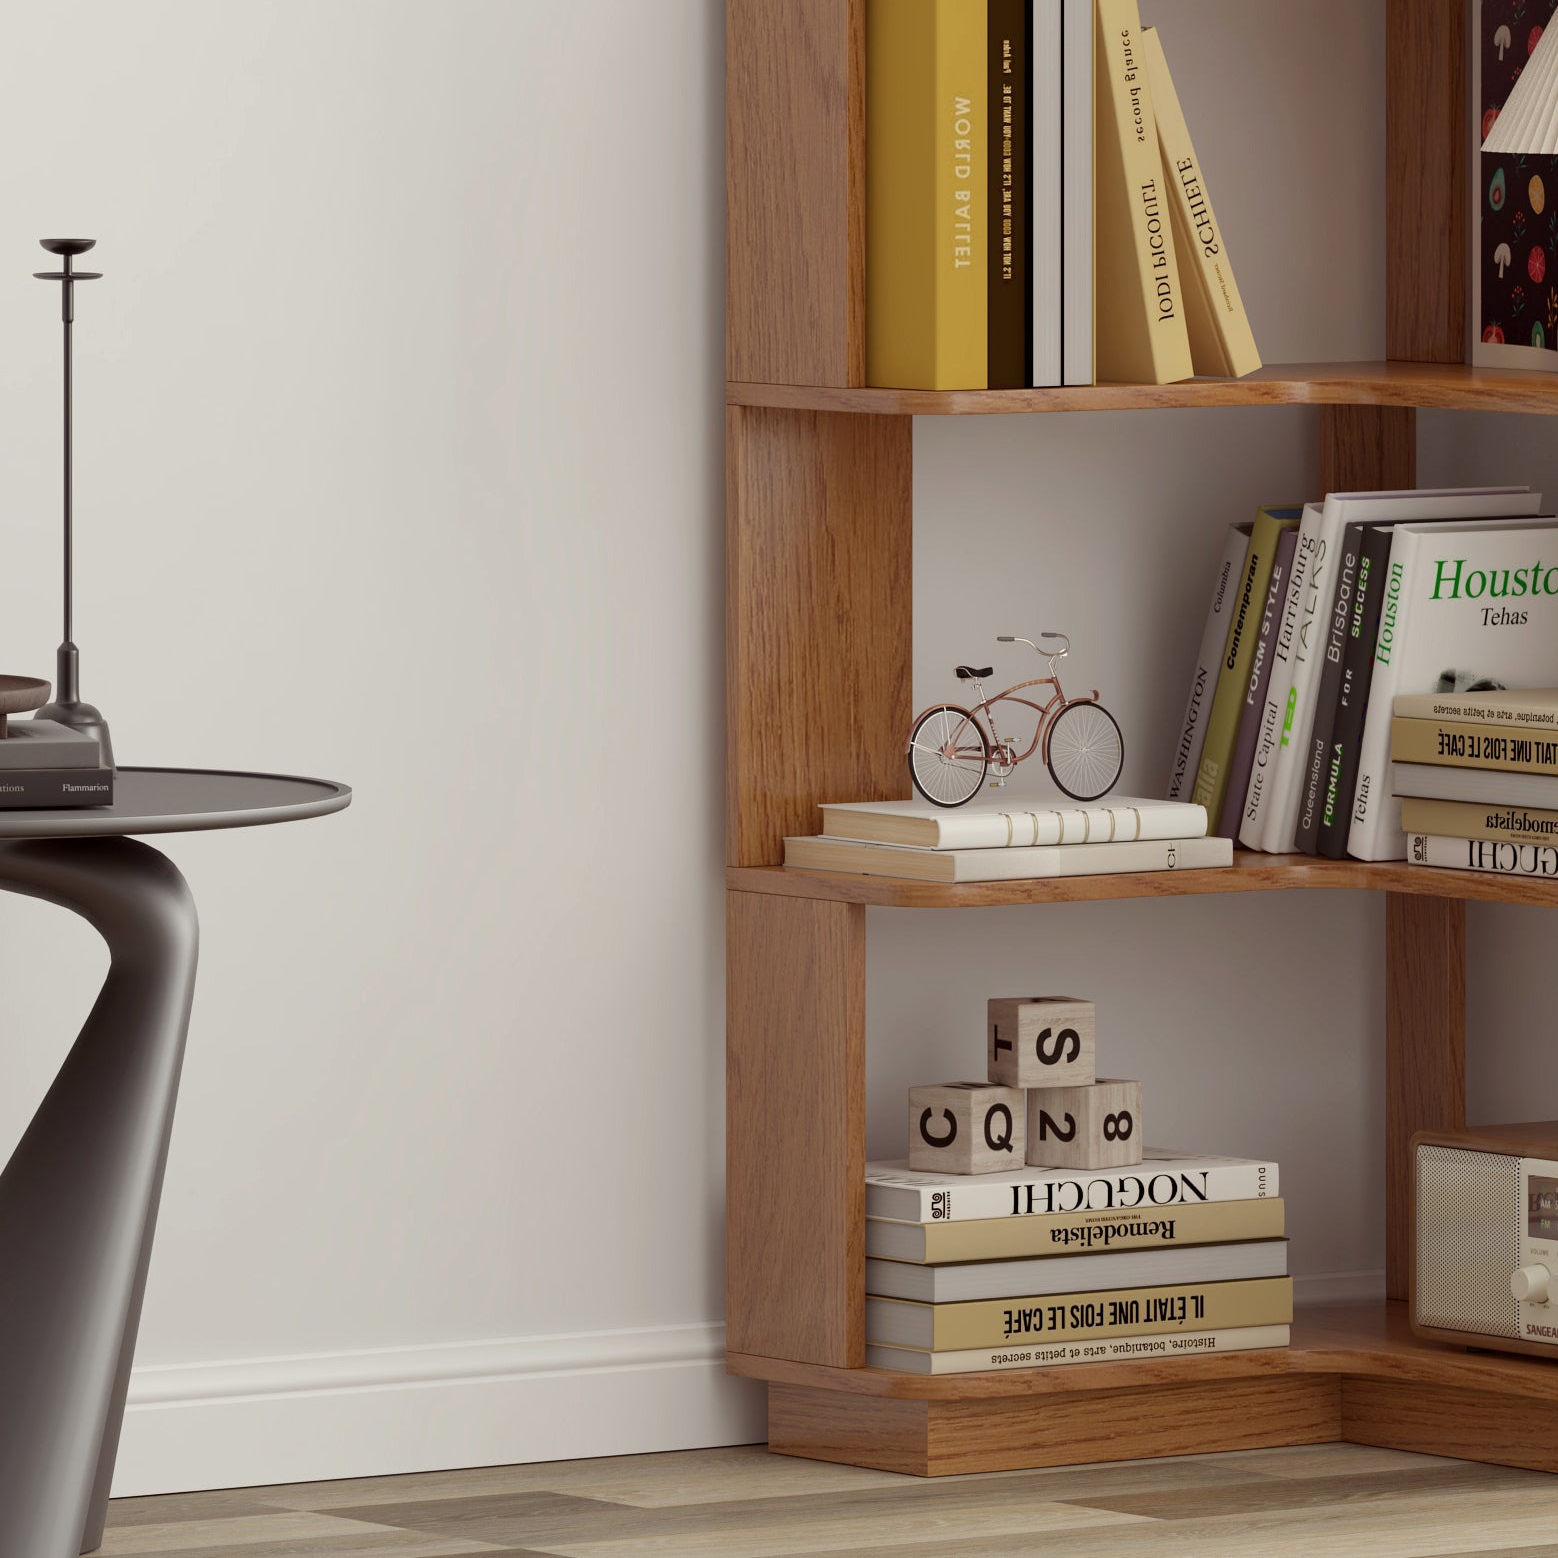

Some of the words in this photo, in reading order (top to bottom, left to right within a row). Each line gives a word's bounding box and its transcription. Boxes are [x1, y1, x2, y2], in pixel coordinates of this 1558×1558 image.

[1226, 554, 1259, 671] Contemporan
[1276, 533, 1316, 663] Harrisburg
[1327, 553, 1356, 663] Brisbane
[1376, 562, 1404, 667] Houston
[1480, 607, 1529, 626] Tehas
[1246, 639, 1267, 706] FORM
[1261, 566, 1283, 636] STYLE
[1169, 667, 1208, 798] WASHINGTON
[1214, 561, 1232, 614] Columbia
[1323, 743, 1344, 827] FORMULA
[1341, 669, 1353, 706] FOR
[1351, 556, 1371, 638] SUCCESS
[1247, 773, 1264, 821] State
[1257, 700, 1279, 768] Capital
[62, 783, 109, 792] Flammarion
[1302, 738, 1325, 830] Queensland
[1353, 774, 1371, 825] Tehas
[994, 1024, 1013, 1062] T
[1036, 1028, 1081, 1066] S
[919, 1107, 957, 1148] C
[984, 1103, 1013, 1153] Q
[1039, 1109, 1076, 1143] 2
[1103, 1110, 1133, 1142] 8
[1010, 1171, 1209, 1215] NOGUCHI
[1050, 1219, 1177, 1247] Remodelista
[1004, 1308, 1043, 1338] CAFÉ
[1048, 1306, 1065, 1330] LE
[1070, 1303, 1104, 1329] FOIS
[1109, 1300, 1139, 1326] UNE
[1144, 1296, 1187, 1325] ÉTAIT
[1194, 1295, 1204, 1319] IL
[991, 1351, 1032, 1365] secrets
[1035, 1347, 1067, 1361] petits
[1083, 1344, 1106, 1356] arts
[1109, 1340, 1166, 1354] botanique,
[1169, 1337, 1216, 1351] Histoire,
